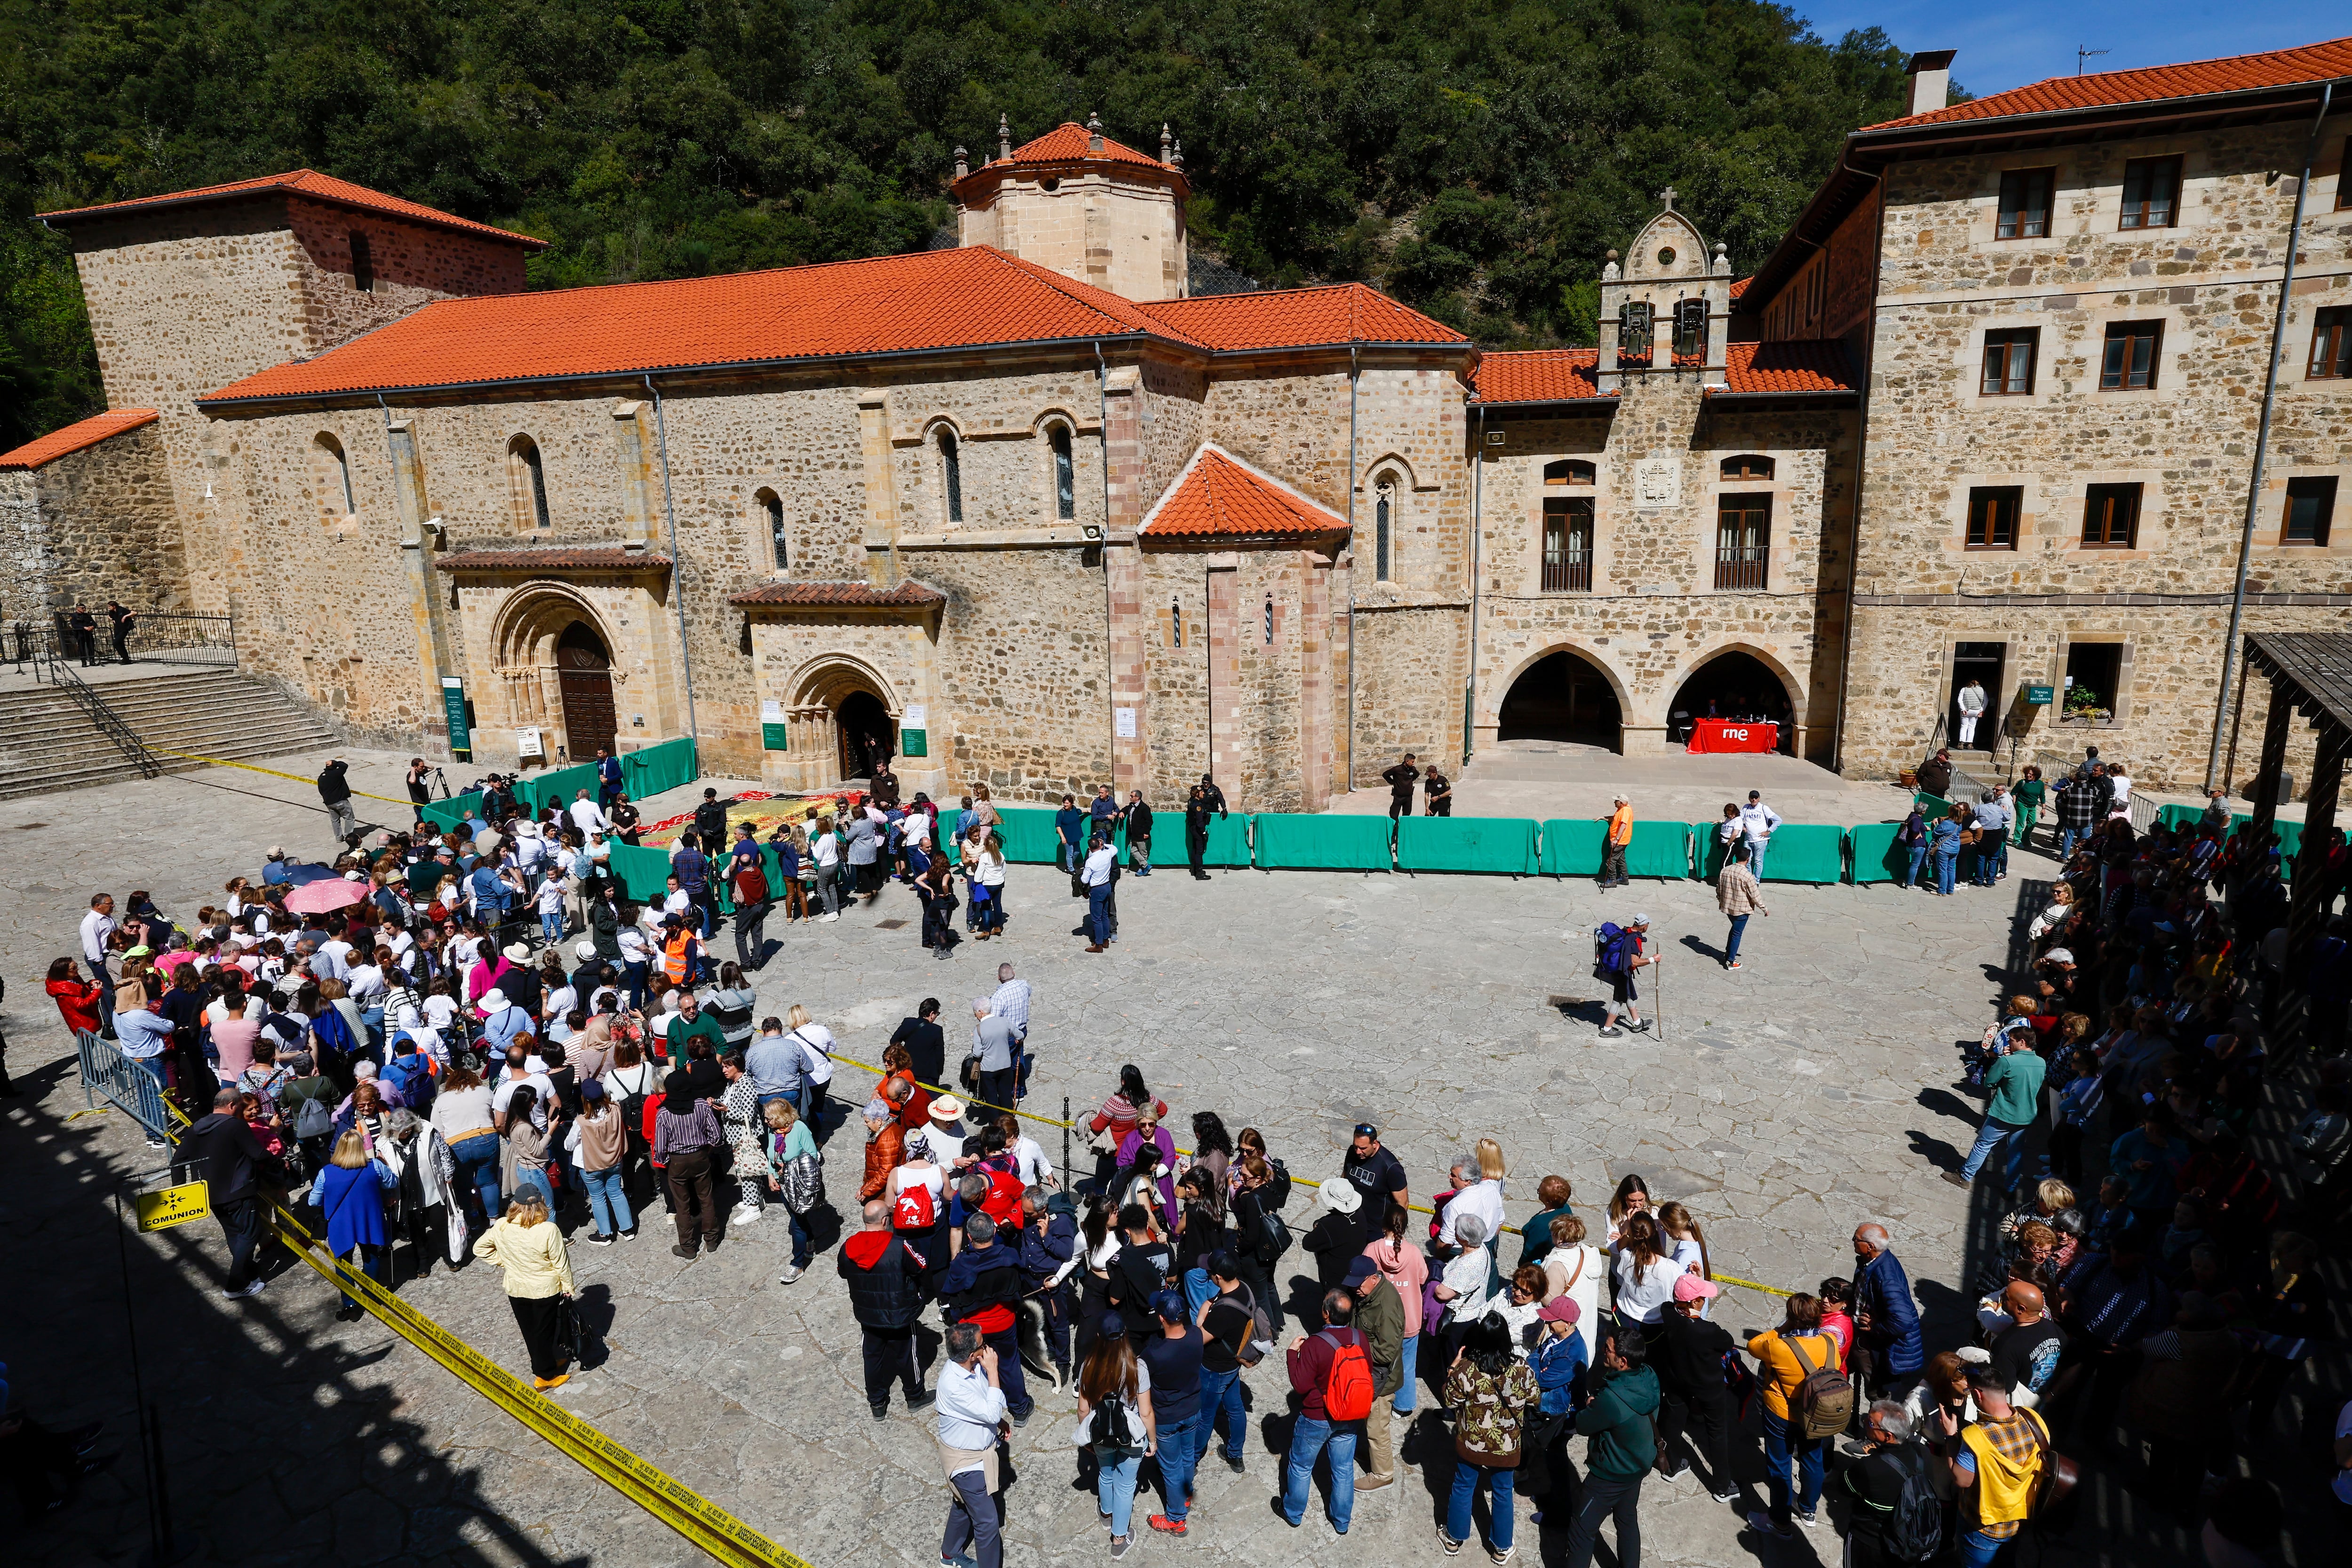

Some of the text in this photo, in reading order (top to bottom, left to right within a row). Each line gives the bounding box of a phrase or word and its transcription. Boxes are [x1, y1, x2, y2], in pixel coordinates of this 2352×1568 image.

[1723, 728, 1748, 741] rne
[144, 1208, 204, 1226] COMUNION
[634, 1466, 656, 1483] info@dassegur.com
[665, 1482, 683, 1499] DASSEGUR
[700, 1510, 725, 1528] info@dassegur.com
[735, 1526, 755, 1544] DASSEGUR
